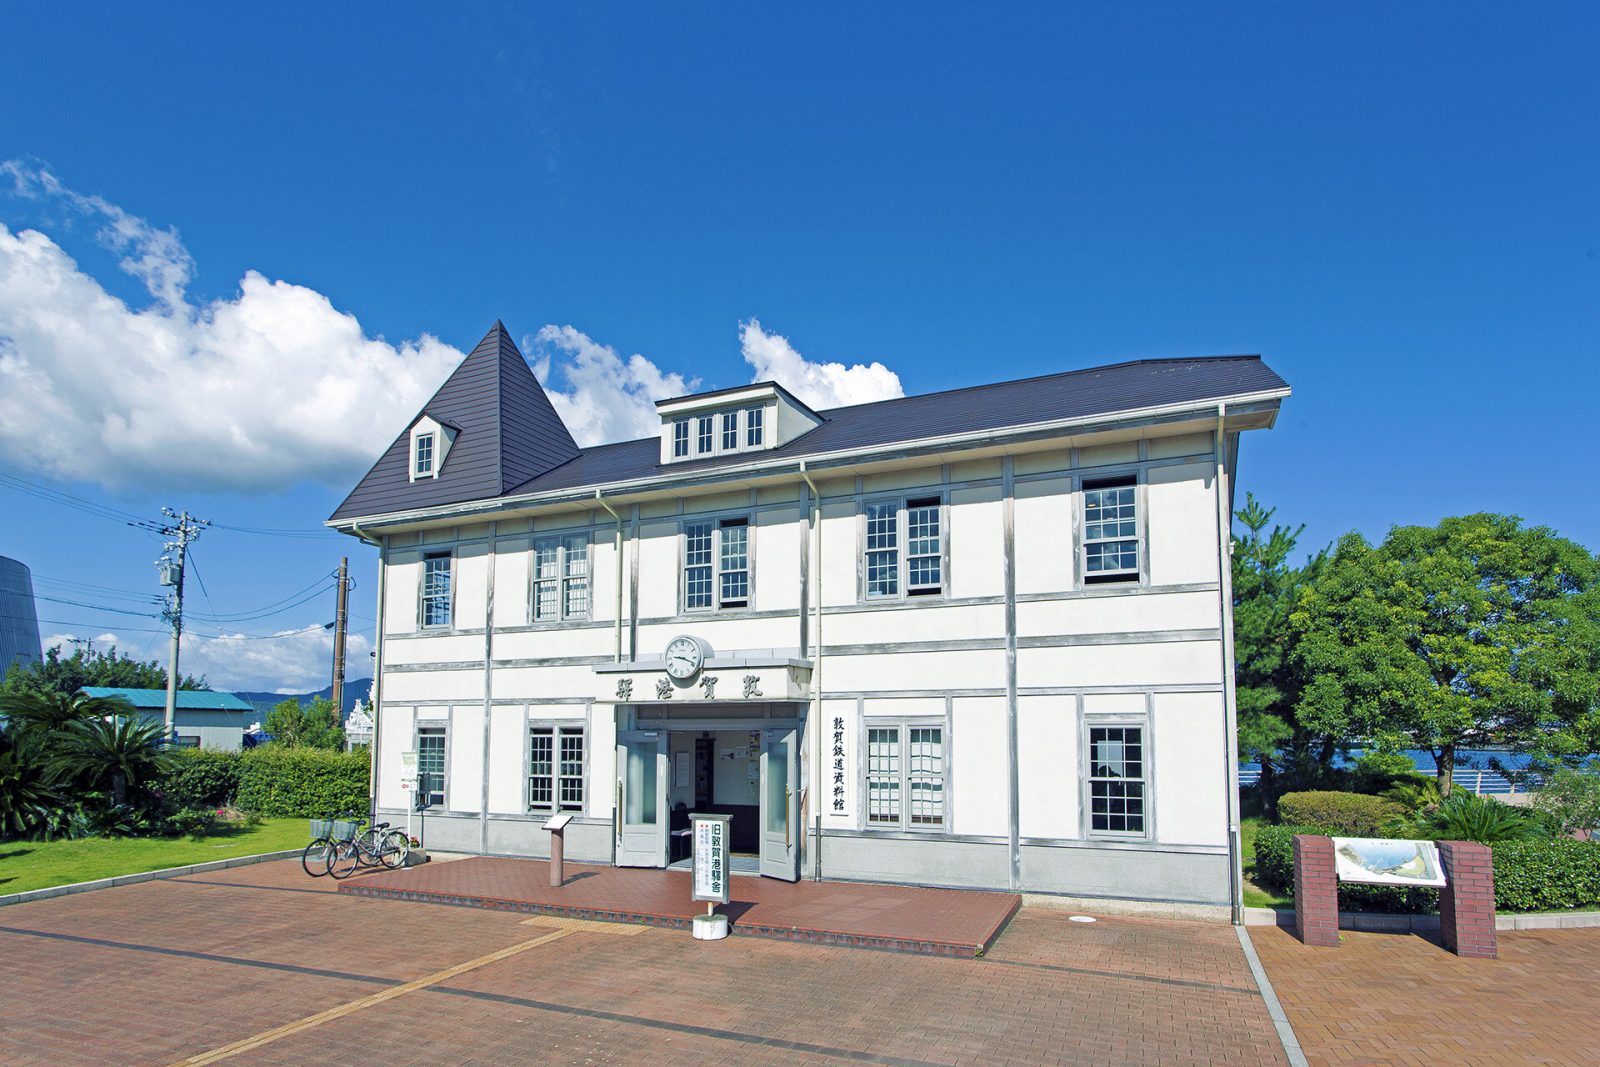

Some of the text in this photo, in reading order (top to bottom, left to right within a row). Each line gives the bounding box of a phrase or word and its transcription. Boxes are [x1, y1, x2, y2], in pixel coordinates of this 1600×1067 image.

[832, 717, 845, 811] 敦賀鉄道資料館
